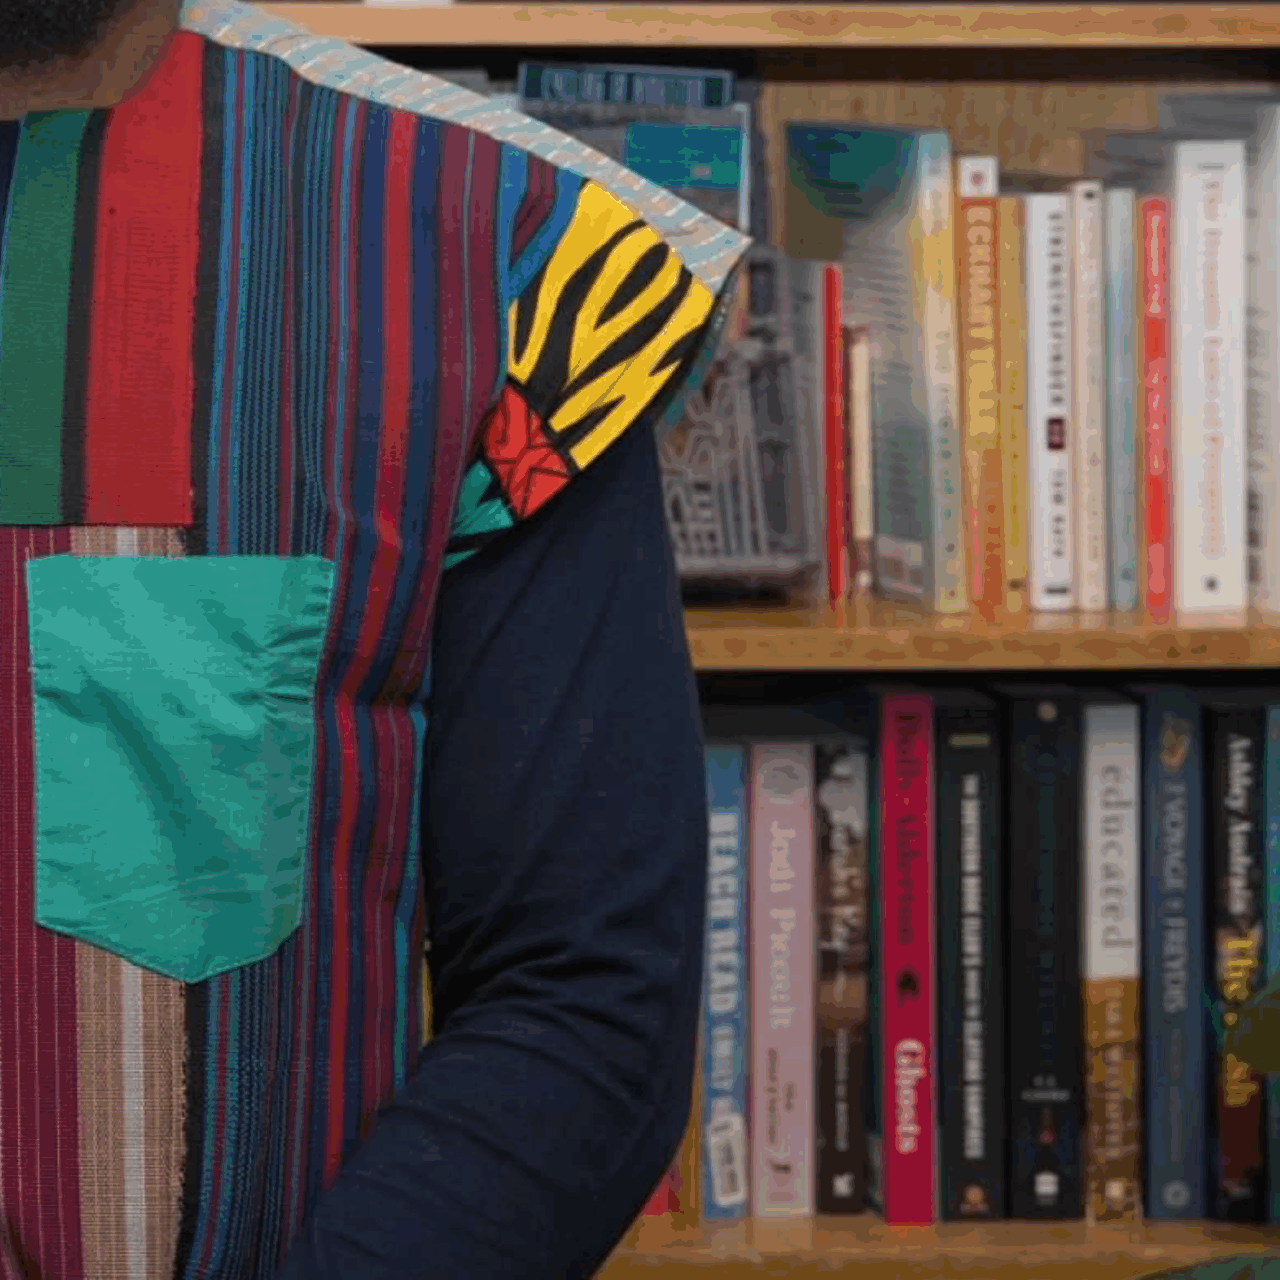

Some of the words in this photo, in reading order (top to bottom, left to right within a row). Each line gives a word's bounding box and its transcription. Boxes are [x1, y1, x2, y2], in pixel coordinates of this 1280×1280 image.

[768, 822, 797, 892] Jodi
[1100, 764, 1135, 949] educated
[895, 1040, 926, 1154] Ghosts
